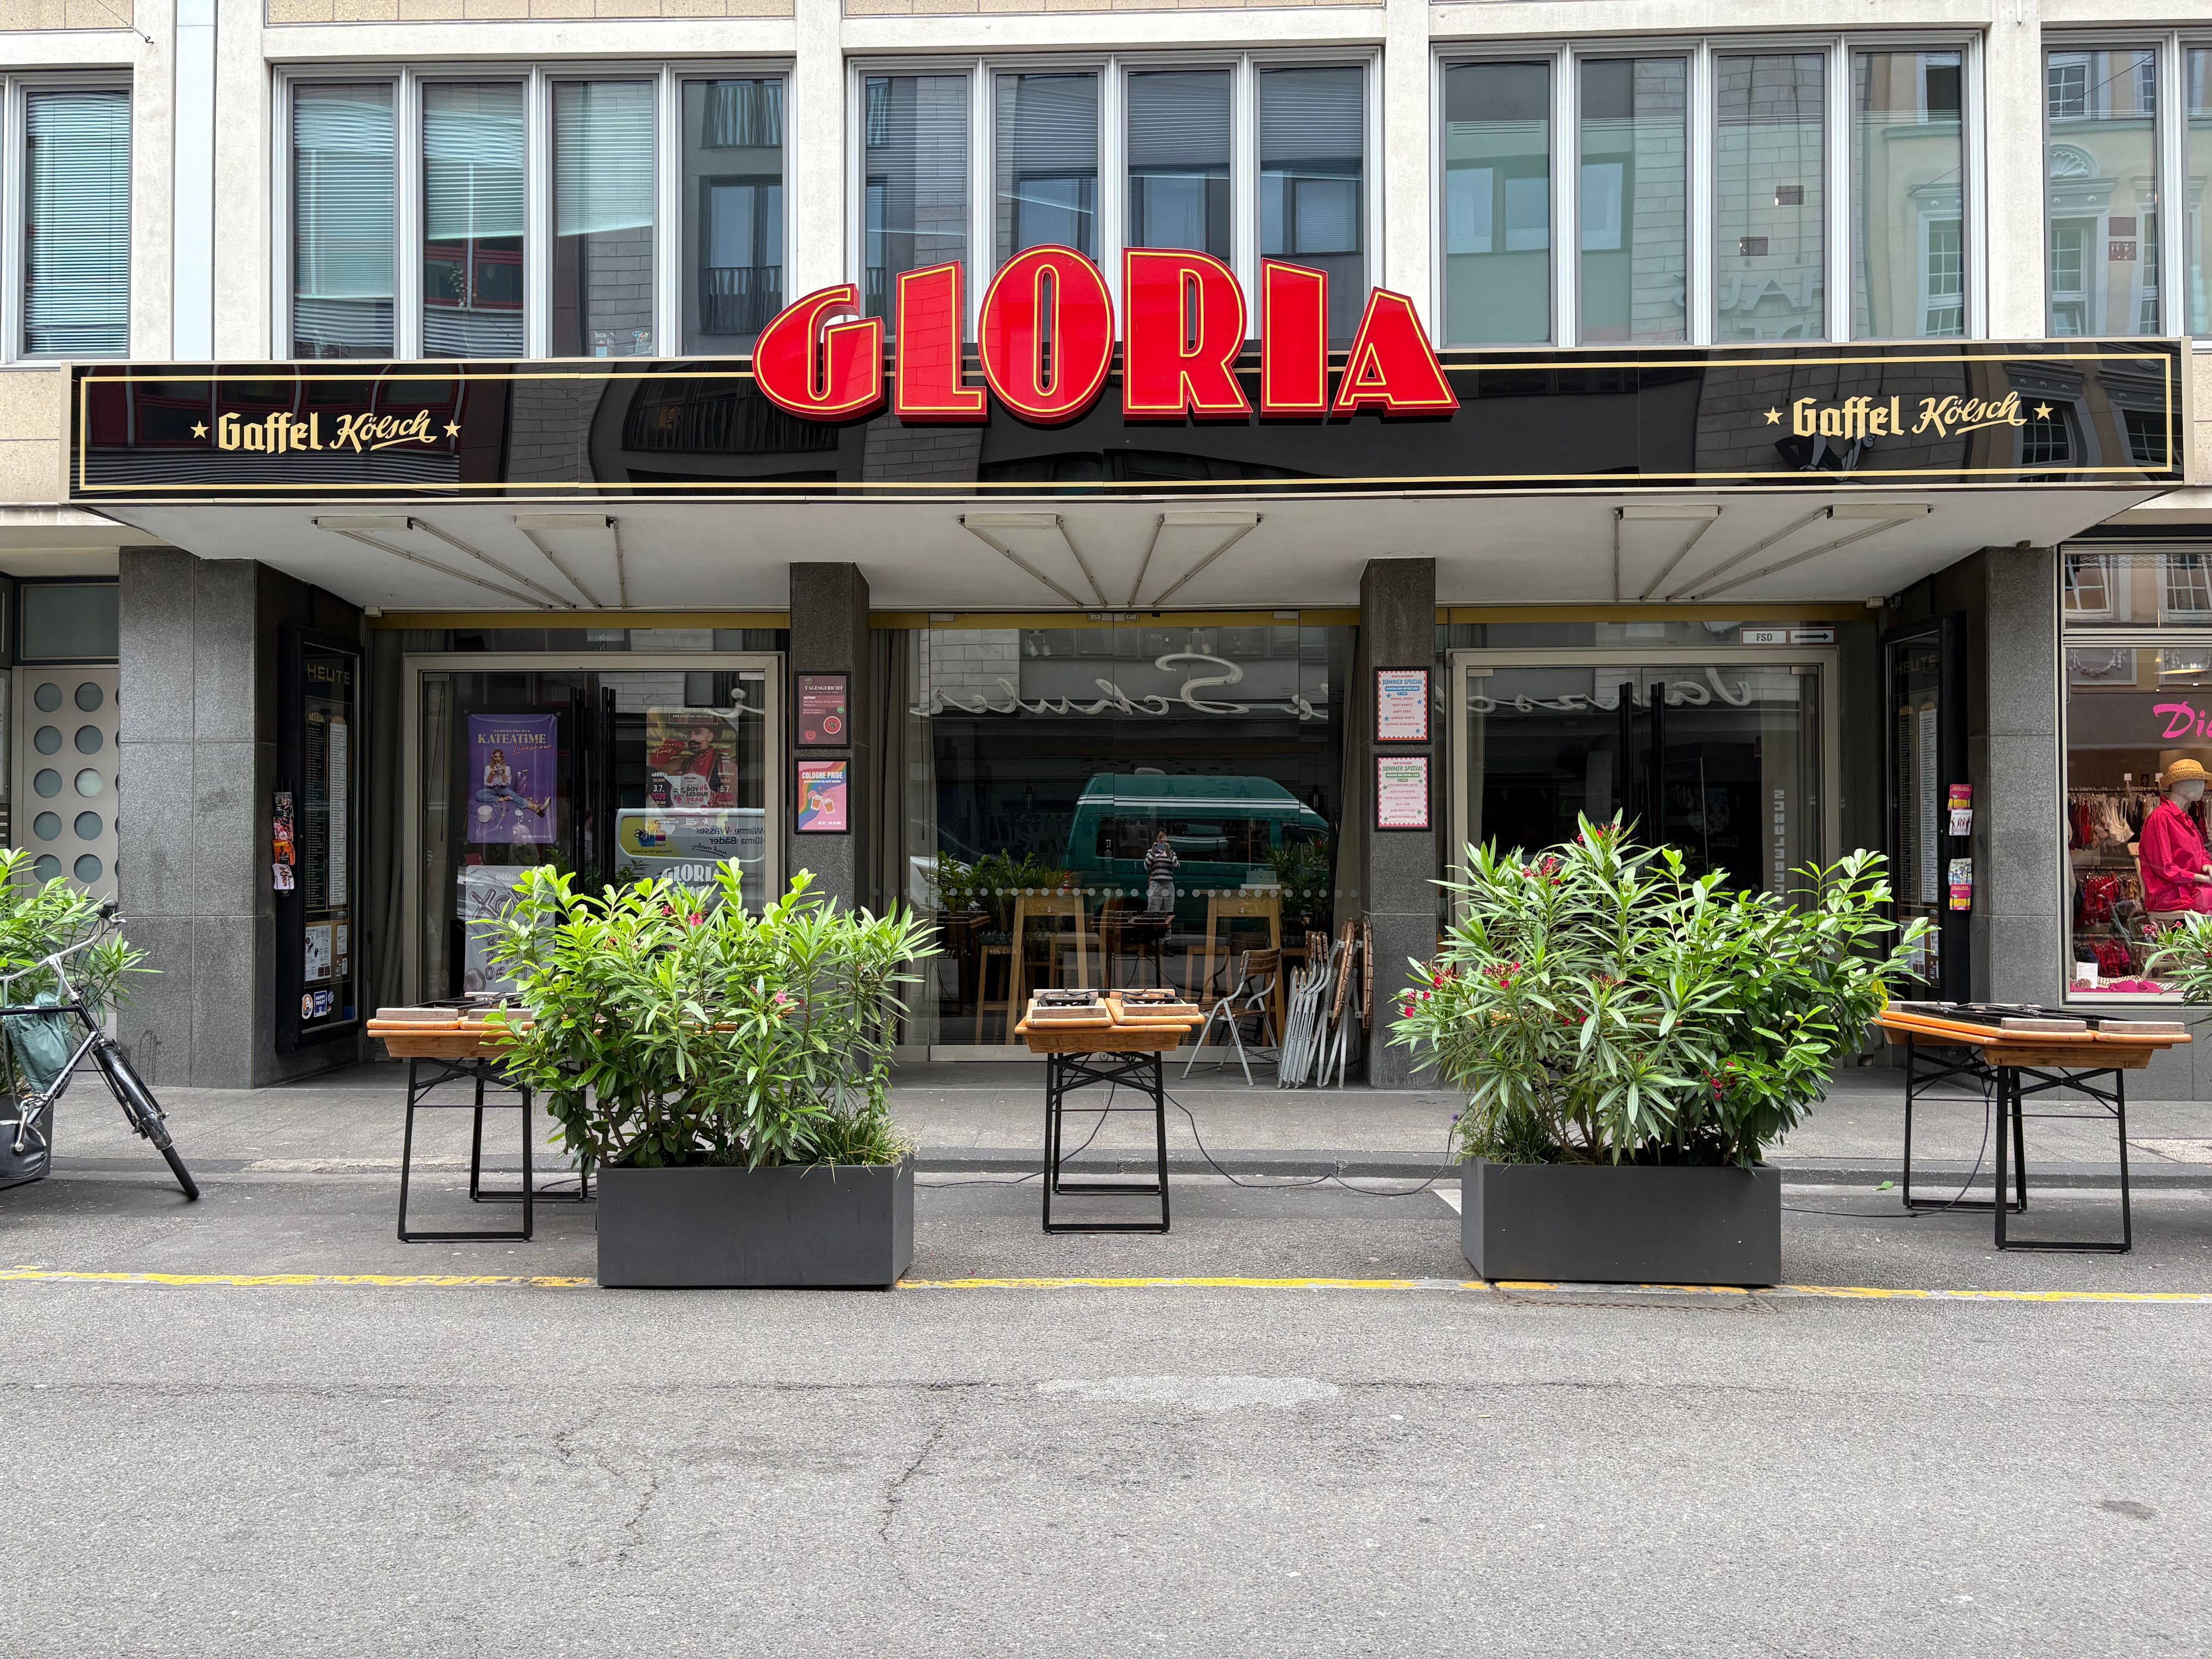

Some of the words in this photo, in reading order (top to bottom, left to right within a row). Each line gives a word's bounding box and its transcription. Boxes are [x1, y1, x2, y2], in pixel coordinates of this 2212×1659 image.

[752, 244, 1460, 423] GLORIA
[218, 411, 323, 455] Gaffel
[330, 409, 437, 453] Kölsch
[1793, 396, 1904, 440] Gaffel
[1912, 391, 2027, 438] Kölsch
[1756, 633, 1773, 641] FSD
[307, 663, 350, 685] HEUTE
[1895, 654, 1938, 674] HEUTE
